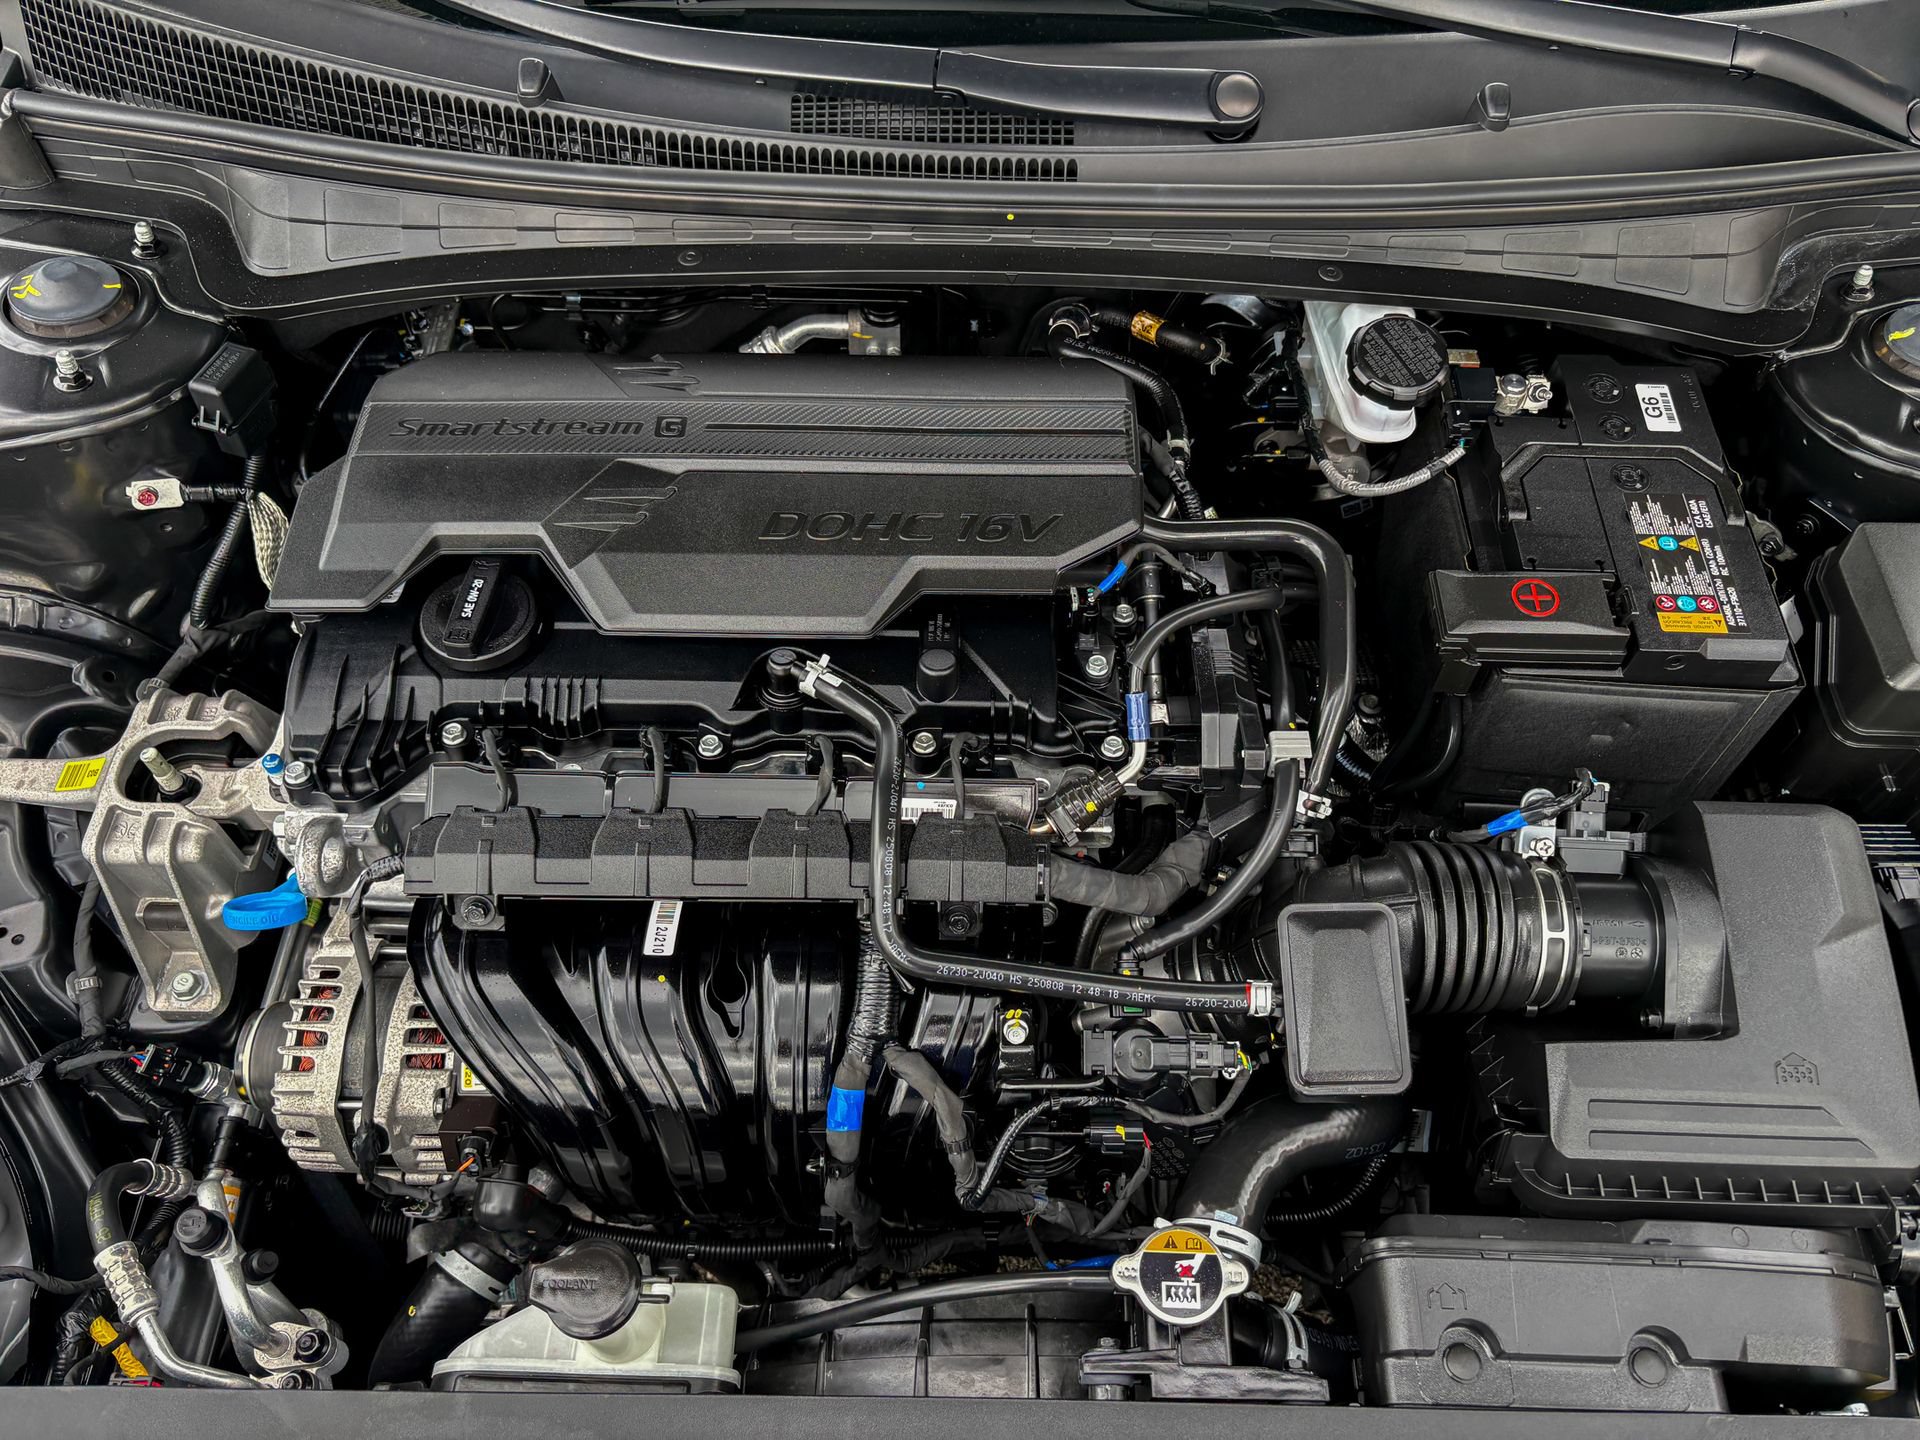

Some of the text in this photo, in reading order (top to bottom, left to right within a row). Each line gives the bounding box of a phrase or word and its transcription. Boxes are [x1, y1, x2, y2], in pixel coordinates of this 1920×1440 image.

[1641, 396, 1663, 419] G6
[389, 416, 686, 437] Smartstream G
[758, 511, 1065, 542] DOHC 16V
[1688, 499, 1704, 528] CCA 640A
[1700, 538, 1720, 576] 60Ah (20HR)
[1714, 545, 1730, 576] RC 100min
[461, 579, 484, 618] SAE 0W-20
[889, 756, 902, 813] 26730-2J040
[887, 817, 896, 832] HS
[883, 836, 895, 876] 250808
[881, 883, 892, 933] 12:48:17
[652, 926, 669, 954] 2J210
[936, 964, 1004, 983] 26730-2J040
[1009, 973, 1022, 985] HS
[1027, 975, 1064, 992] 250808
[1071, 983, 1120, 1000] 12:48:18
[1185, 996, 1248, 1009] 26730-2J04
[542, 1278, 597, 1290] COOLANT
